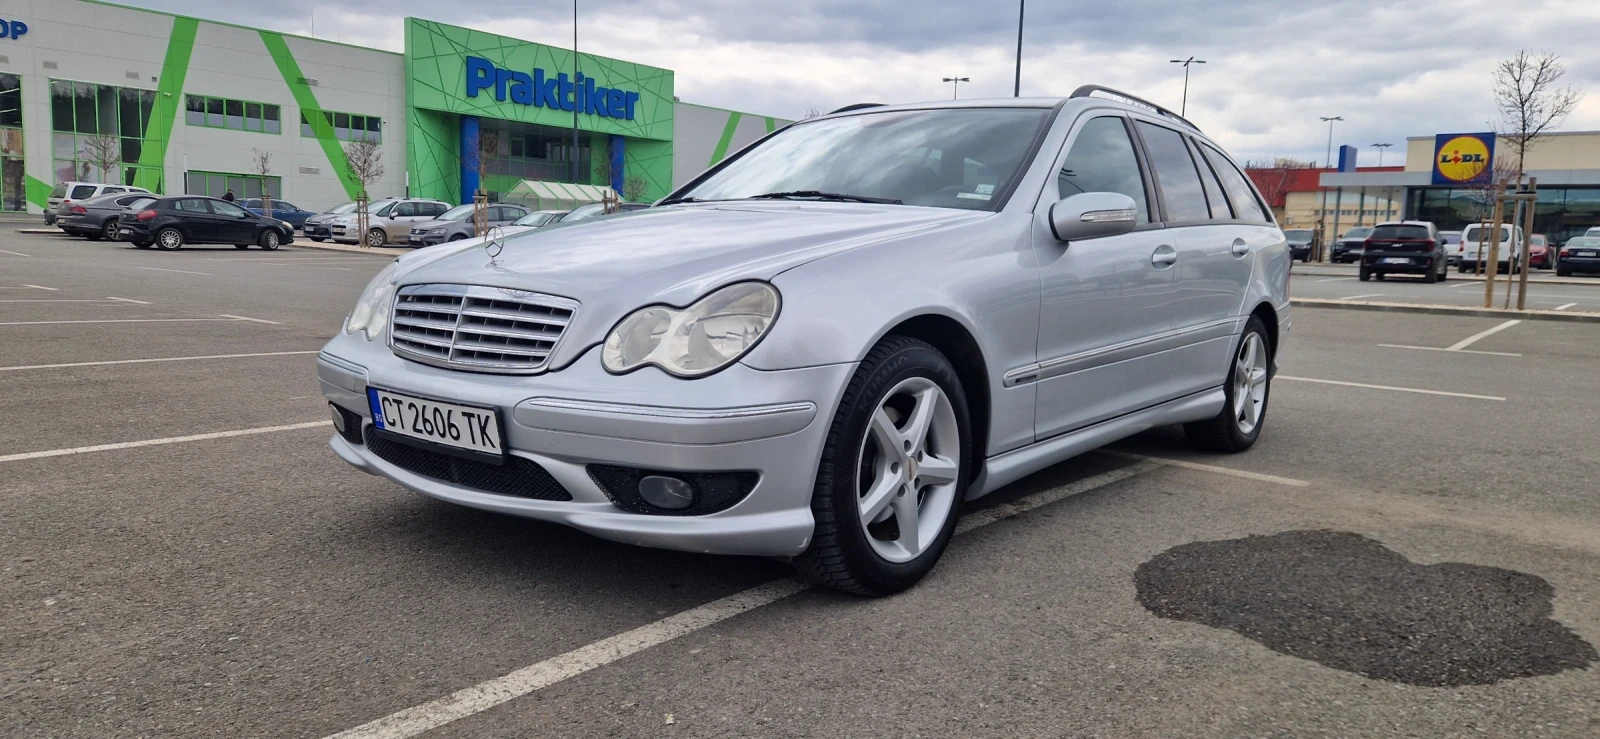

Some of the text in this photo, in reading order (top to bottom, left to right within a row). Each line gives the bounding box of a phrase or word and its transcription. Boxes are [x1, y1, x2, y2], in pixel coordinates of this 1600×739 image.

[466, 55, 640, 121] Praktiker
[381, 396, 497, 448] CT 2606 TK
